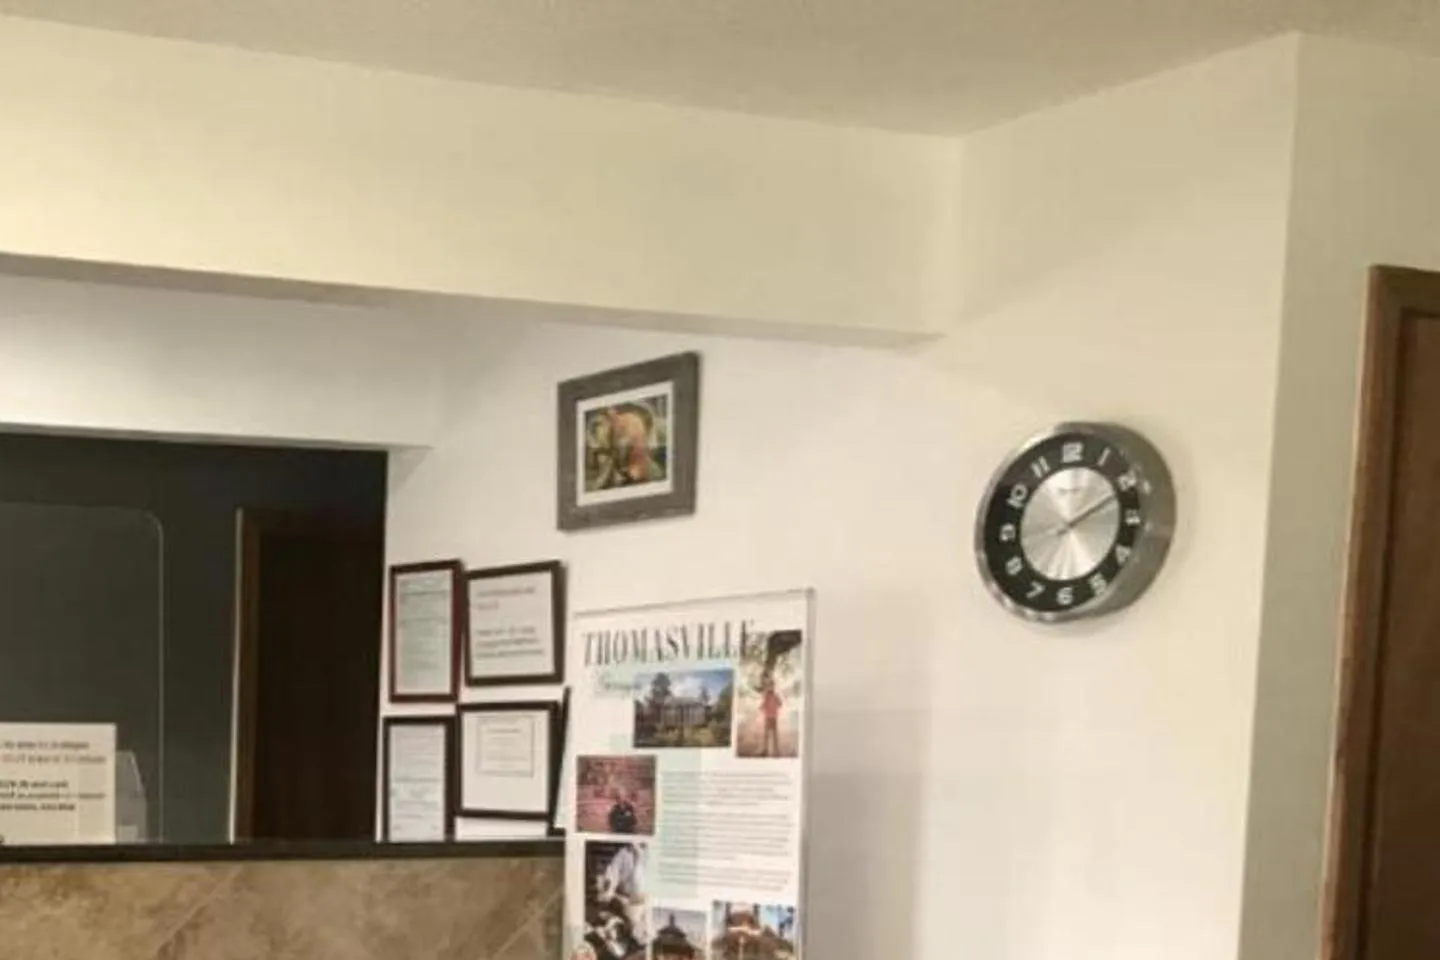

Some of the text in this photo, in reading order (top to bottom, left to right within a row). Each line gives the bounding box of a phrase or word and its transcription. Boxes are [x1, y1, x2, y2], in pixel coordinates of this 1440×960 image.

[1062, 441, 1084, 463] 12
[1031, 456, 1051, 478] 11
[1007, 483, 1028, 508] 10
[1026, 581, 1045, 598] 7
[581, 618, 756, 667] THOMASVILLE
